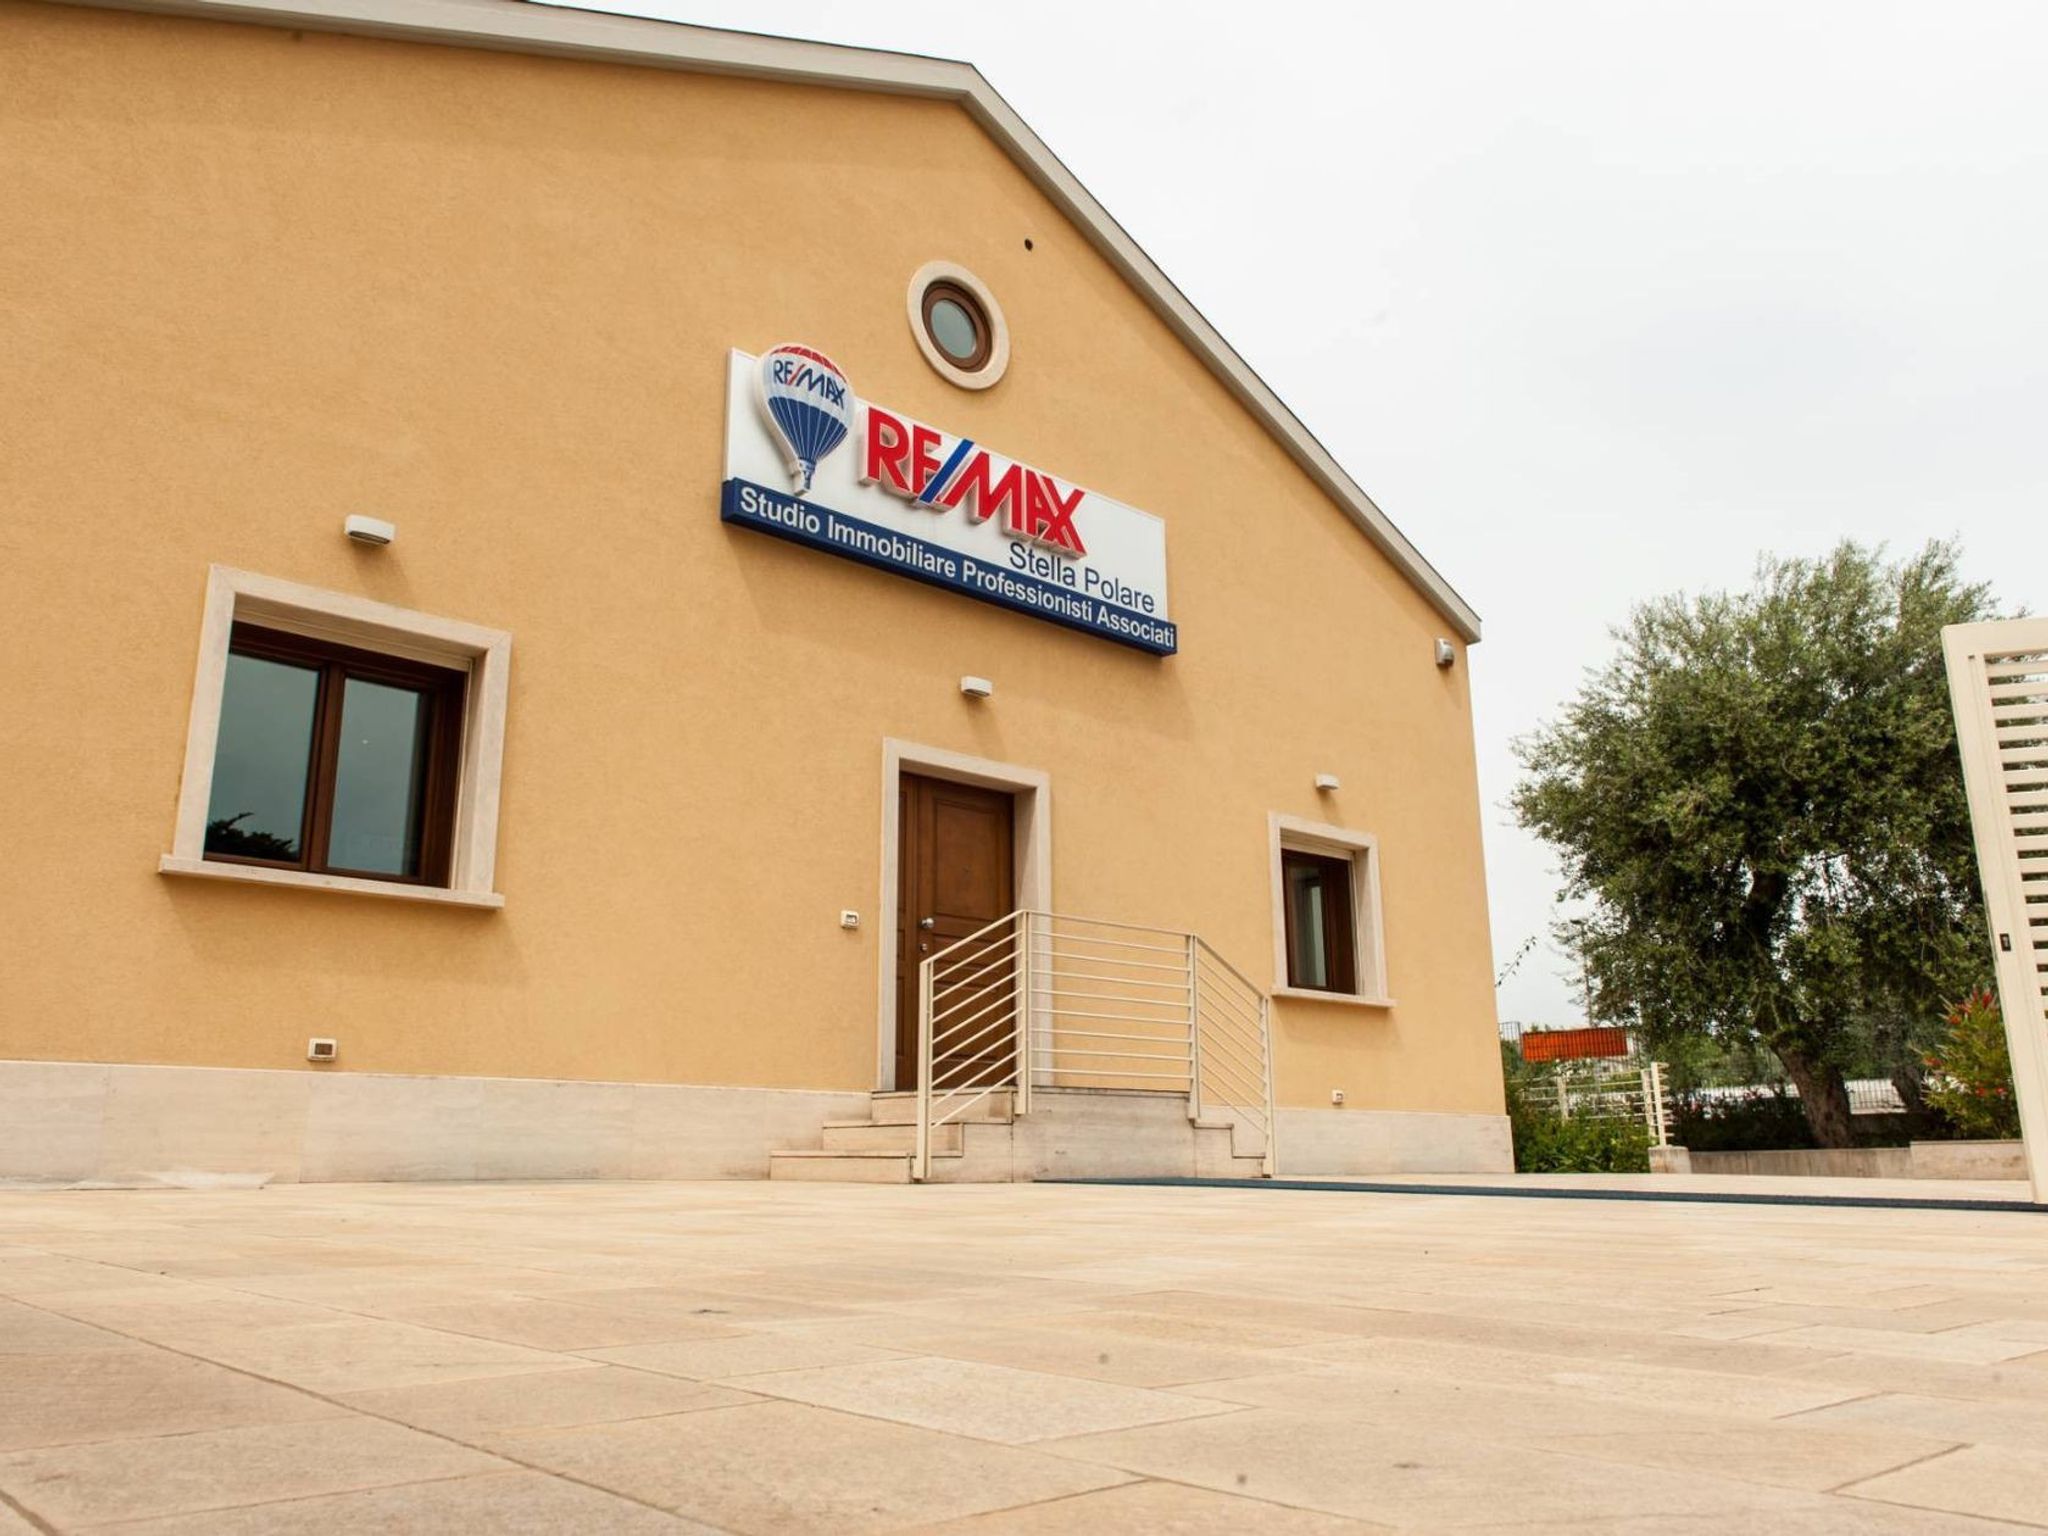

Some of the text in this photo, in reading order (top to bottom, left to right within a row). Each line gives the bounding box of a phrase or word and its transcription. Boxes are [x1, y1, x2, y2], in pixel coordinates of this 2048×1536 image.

[773, 359, 846, 409] RE/MAX
[866, 406, 1087, 555] RE/MAX
[740, 485, 1175, 648] Studio Immobiliare Professionisti Associati
[1009, 542, 1155, 613] Stella Polare
